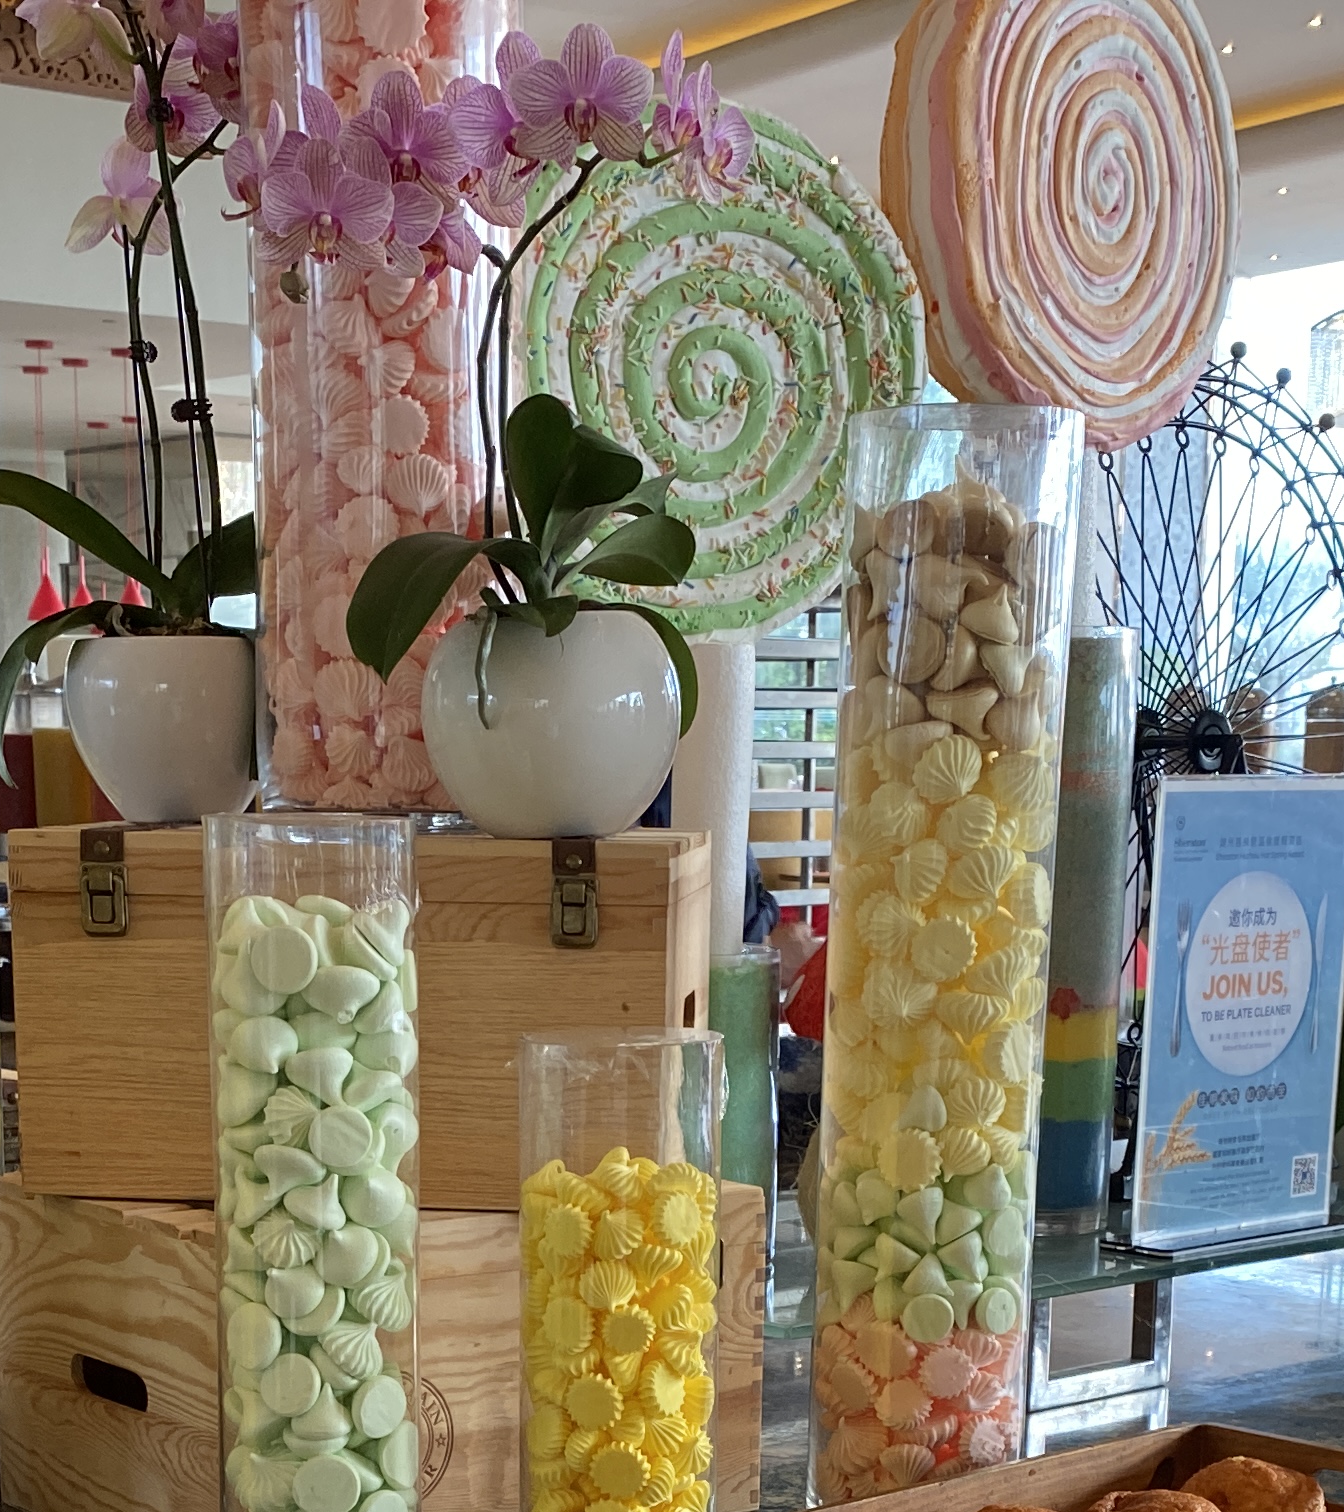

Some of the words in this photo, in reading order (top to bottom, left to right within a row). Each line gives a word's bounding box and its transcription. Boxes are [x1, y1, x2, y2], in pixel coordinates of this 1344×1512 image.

[1228, 907, 1277, 928] 邀你成为
[1202, 972, 1252, 1001] JOIN
[1257, 970, 1288, 998] US,
[1201, 1011, 1213, 1022] TO
[1214, 1009, 1225, 1021] BE
[1226, 1007, 1253, 1020] PLATE
[1254, 1004, 1292, 1018] CLEANER
